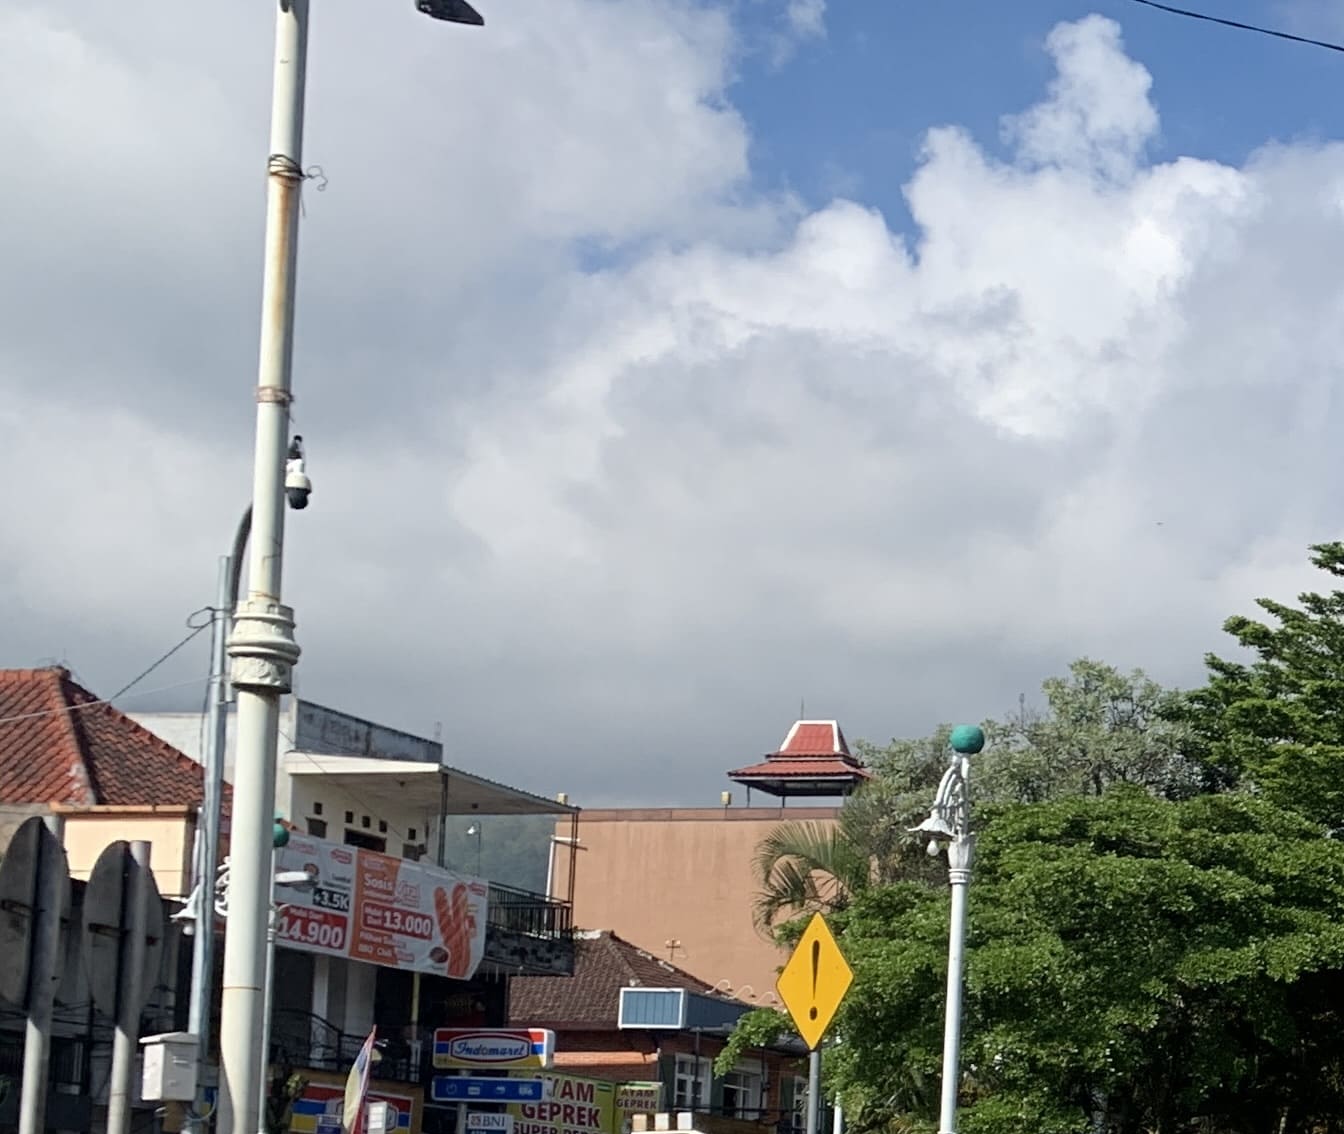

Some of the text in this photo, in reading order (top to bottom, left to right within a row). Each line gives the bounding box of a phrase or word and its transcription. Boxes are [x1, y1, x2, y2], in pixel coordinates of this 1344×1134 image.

[279, 916, 344, 948] 14.900
[384, 910, 432, 937] 13.000
[453, 1040, 526, 1057] Indomaret
[535, 1075, 594, 1104] YAM
[521, 1102, 601, 1129] GEPREK
[616, 1098, 658, 1110] GEPREK
[483, 1115, 506, 1128] BNI
